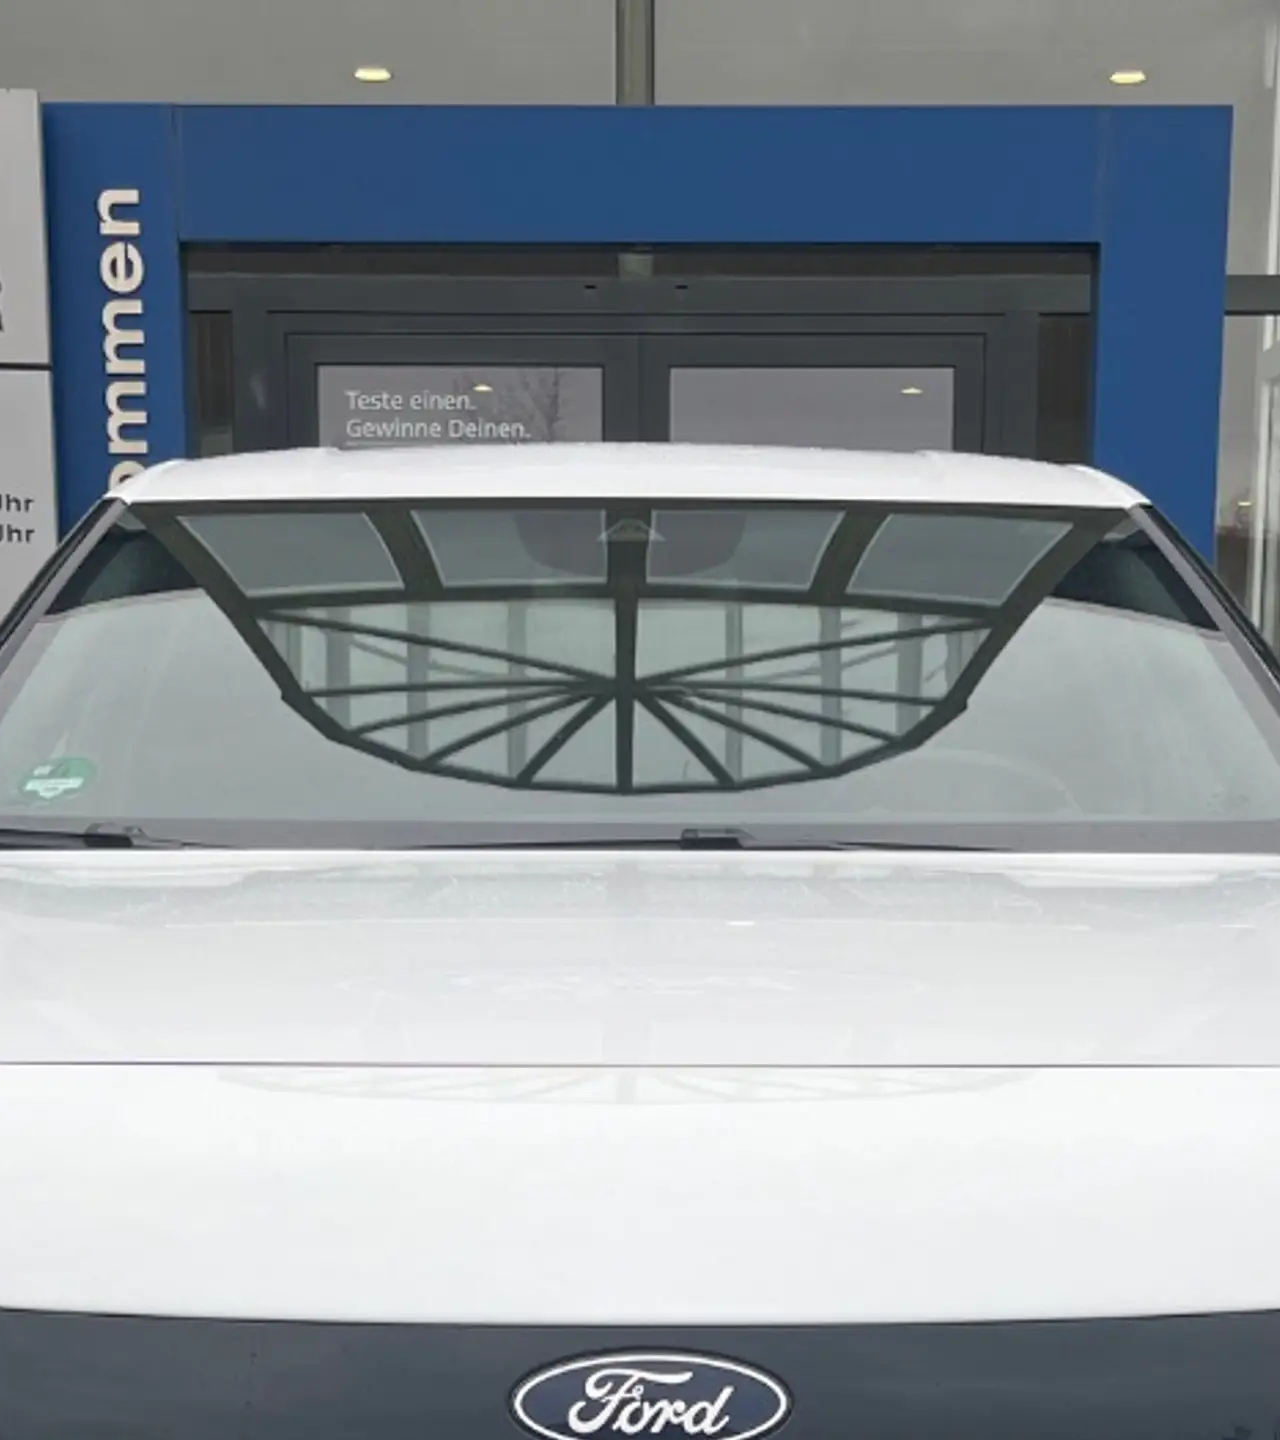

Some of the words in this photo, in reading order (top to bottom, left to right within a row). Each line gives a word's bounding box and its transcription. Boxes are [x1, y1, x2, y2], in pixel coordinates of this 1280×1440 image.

[345, 390, 404, 411] Teste
[409, 390, 477, 411] einen.
[345, 417, 443, 439] Gewinne
[447, 418, 532, 440] Deinen.
[566, 1366, 735, 1436] Ford
